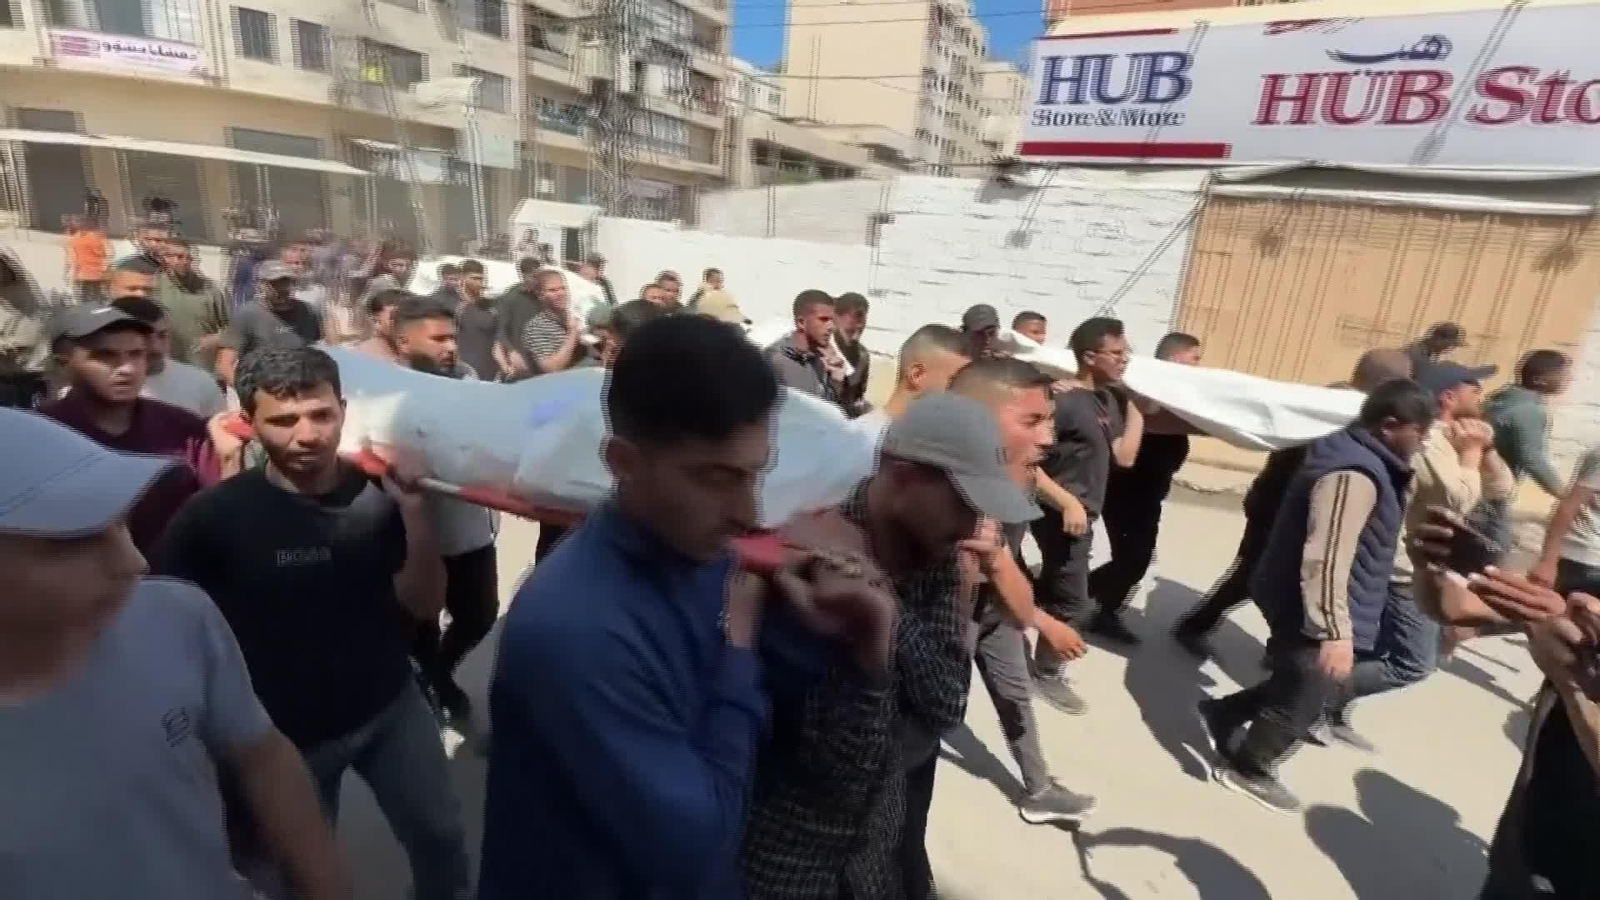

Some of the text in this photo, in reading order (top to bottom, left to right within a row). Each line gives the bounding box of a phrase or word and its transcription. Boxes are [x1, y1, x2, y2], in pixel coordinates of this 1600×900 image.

[1034, 51, 1194, 105] HUB
[1251, 65, 1600, 125] HUB Sto
